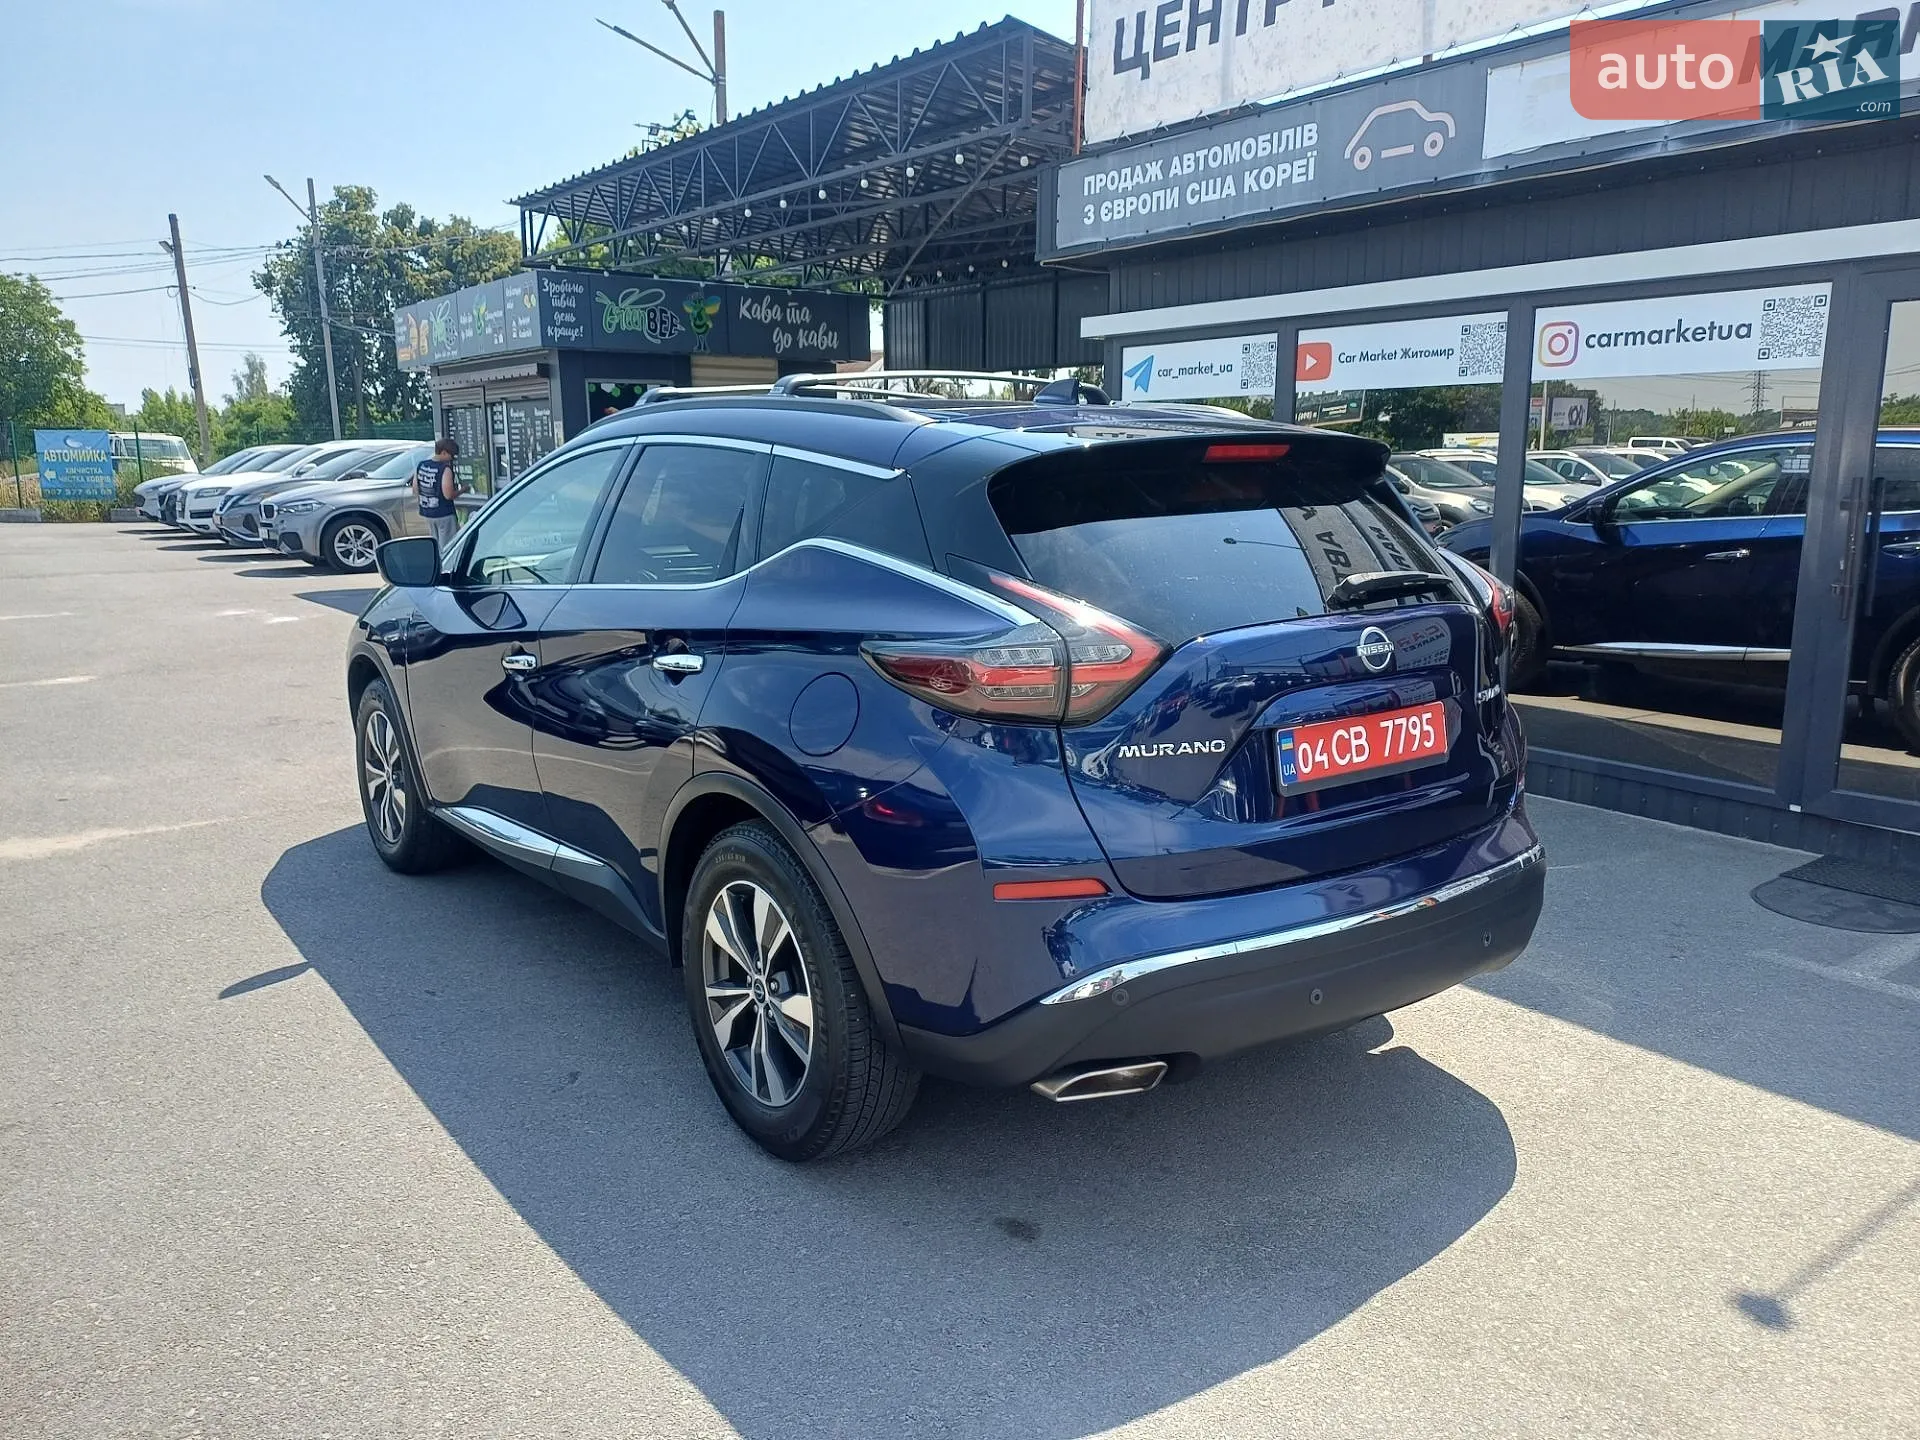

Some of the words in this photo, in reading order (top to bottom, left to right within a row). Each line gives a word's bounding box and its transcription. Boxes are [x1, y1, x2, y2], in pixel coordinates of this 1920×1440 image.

[1083, 159, 1164, 196] ПРОДАЖ
[1169, 122, 1319, 178] АВТОМОБІЛІВ
[1083, 204, 1095, 225] З
[1100, 186, 1180, 223] ЄВРОПИ
[1186, 174, 1237, 205] США
[1243, 150, 1318, 194] КОРЕЇ
[542, 277, 584, 297] Зробимо
[551, 293, 576, 308] твій
[740, 295, 783, 324] Кава
[786, 302, 811, 324] та
[554, 310, 576, 326] день
[547, 325, 584, 342] краще!
[772, 327, 793, 354] до
[797, 321, 840, 350] кави
[1585, 318, 1753, 349] carmarketua
[1338, 352, 1357, 364] Car
[1359, 347, 1397, 362] Market
[1400, 347, 1454, 360] Житомир
[1157, 361, 1233, 379] car_market_ua
[44, 447, 107, 462] АВТОМИЙКА
[1359, 643, 1394, 656] NISSAN
[1379, 712, 1435, 757] 7795
[1118, 739, 1226, 758] MURANO
[1283, 763, 1297, 776] UA
